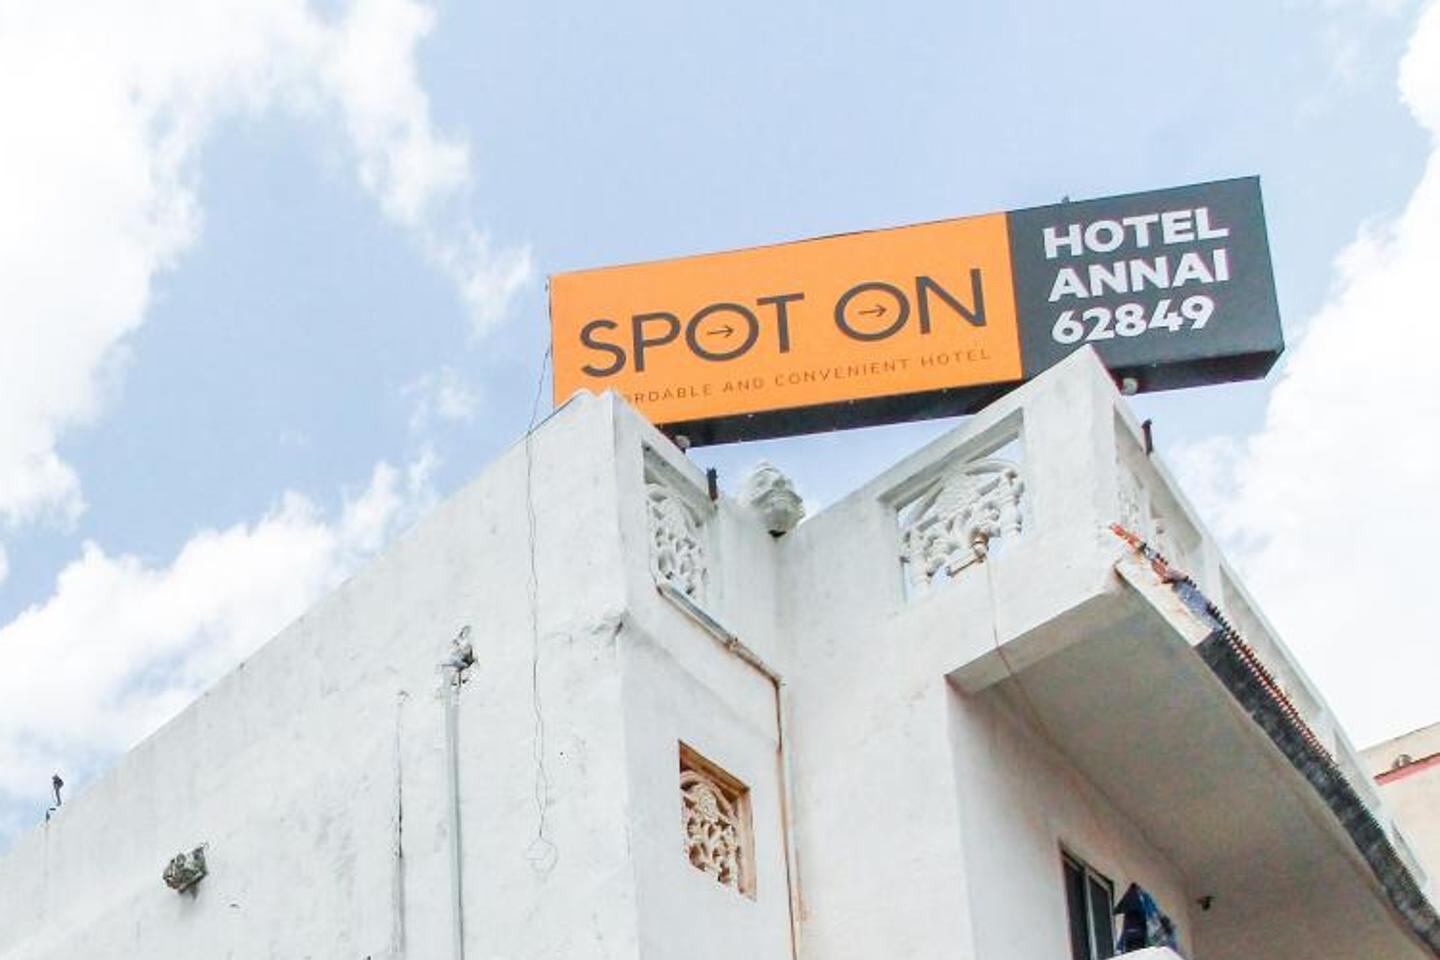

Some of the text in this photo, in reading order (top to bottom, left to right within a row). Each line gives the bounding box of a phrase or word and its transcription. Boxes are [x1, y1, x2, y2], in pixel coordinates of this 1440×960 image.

[1043, 207, 1229, 258] HOTEL
[1048, 249, 1231, 302] ANNAI
[580, 268, 987, 377] SPOT ON
[1051, 295, 1214, 345] 62849
[723, 376, 764, 394] AND
[774, 359, 908, 387] CONVENIENT
[920, 348, 992, 368] HOTEL
